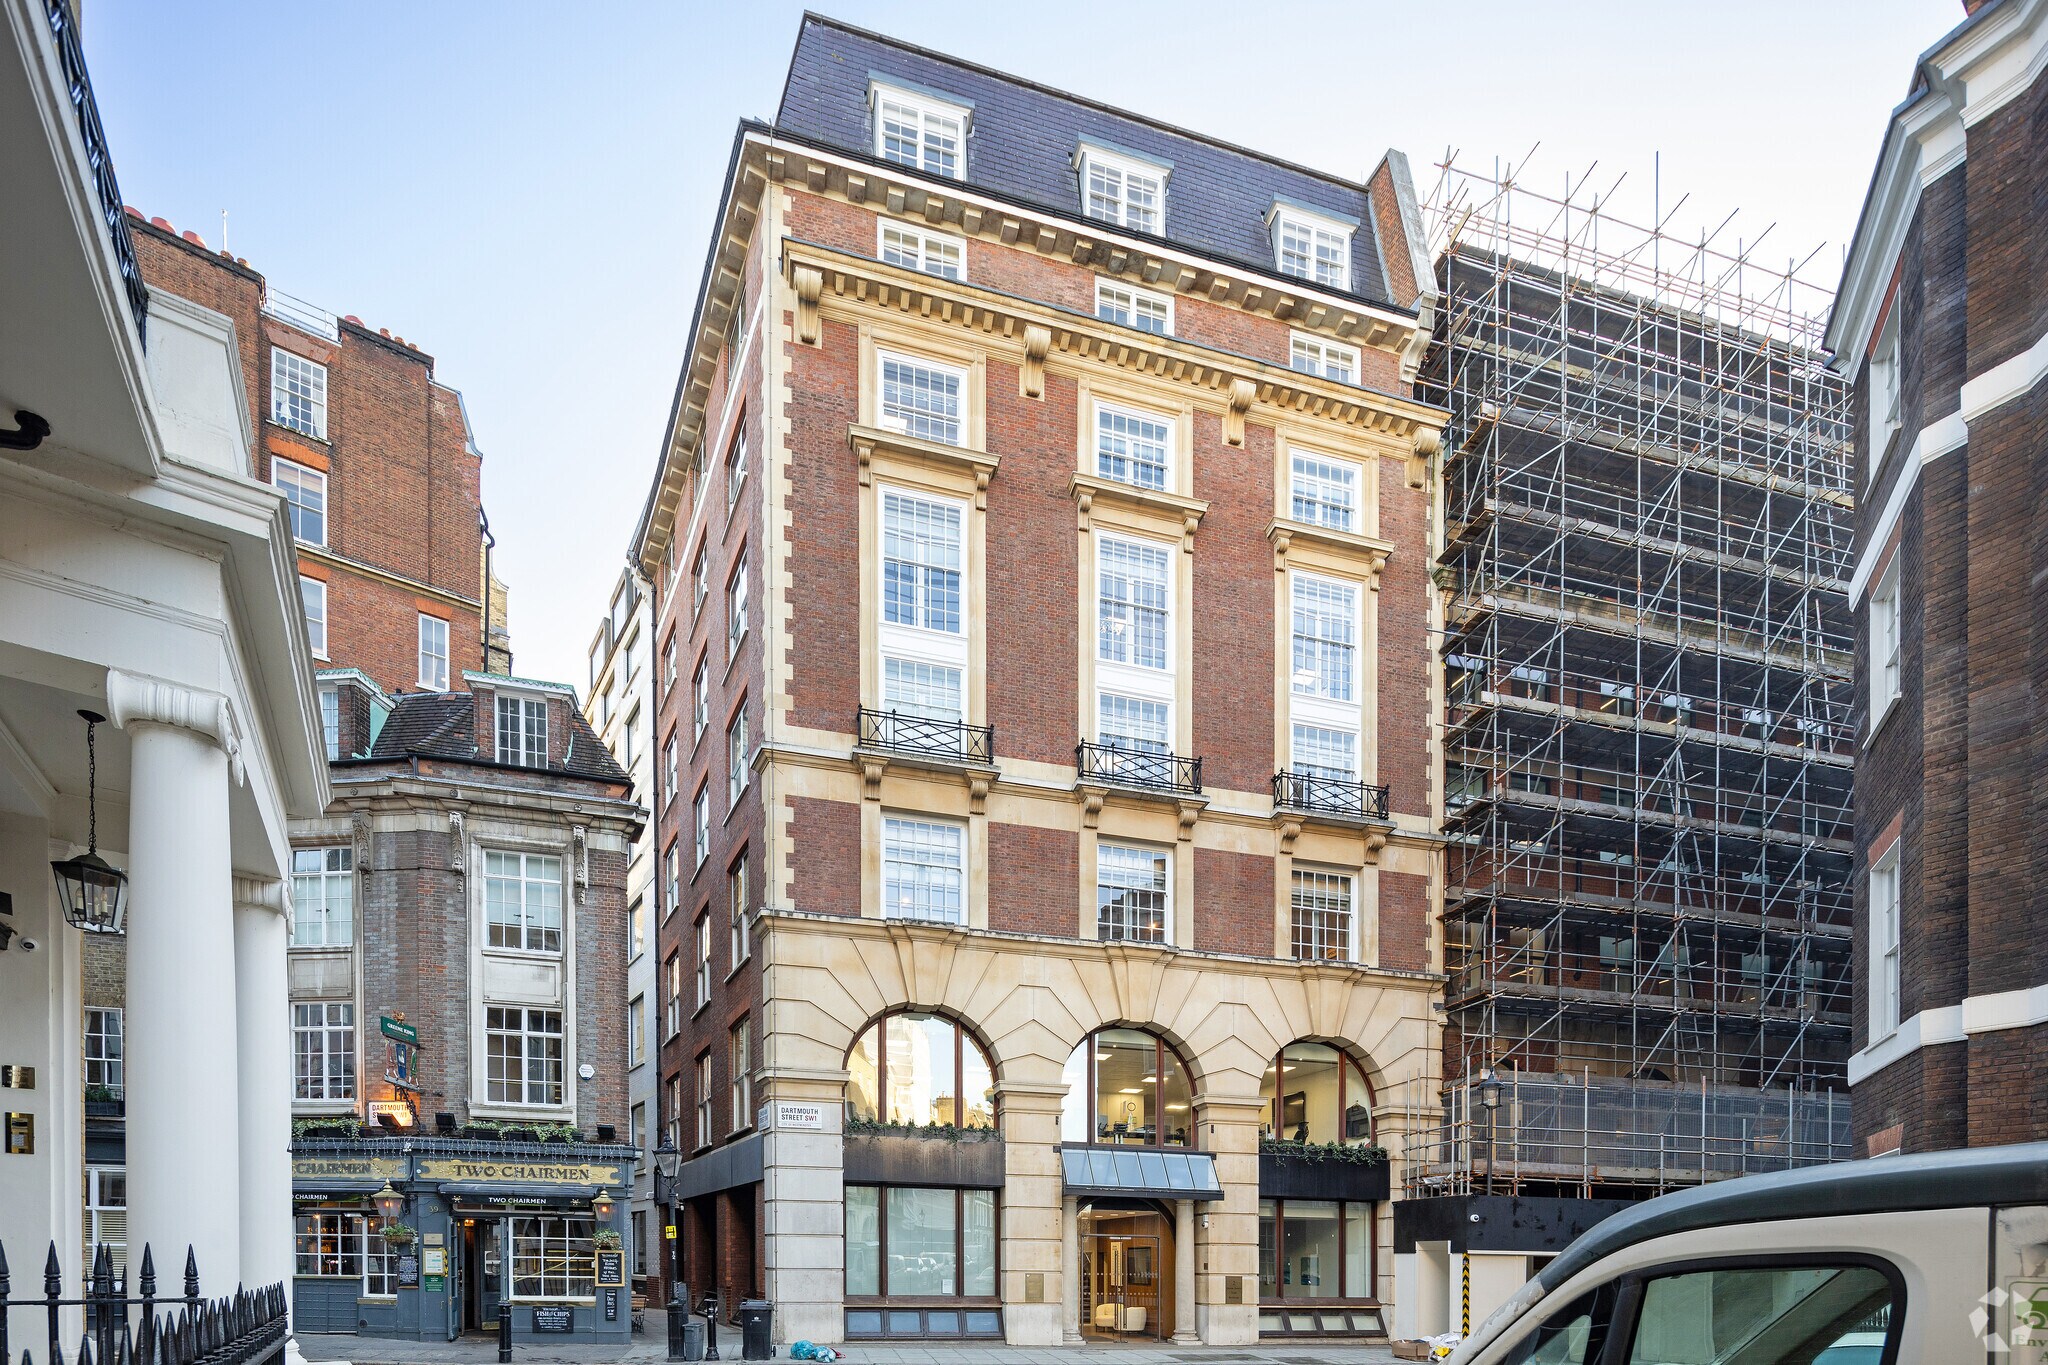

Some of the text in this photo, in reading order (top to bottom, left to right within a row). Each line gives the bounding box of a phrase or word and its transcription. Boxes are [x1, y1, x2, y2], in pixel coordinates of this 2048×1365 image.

[386, 1022, 404, 1033] GREENE
[403, 1028, 415, 1037] KING
[781, 1107, 819, 1115] DARTMOUTH
[295, 1162, 371, 1175] CHAIRMEN
[453, 1164, 590, 1181] TWO CHAIRMEN
[488, 1196, 547, 1205] TWO CHAIRMEN
[428, 1205, 439, 1213] 39
